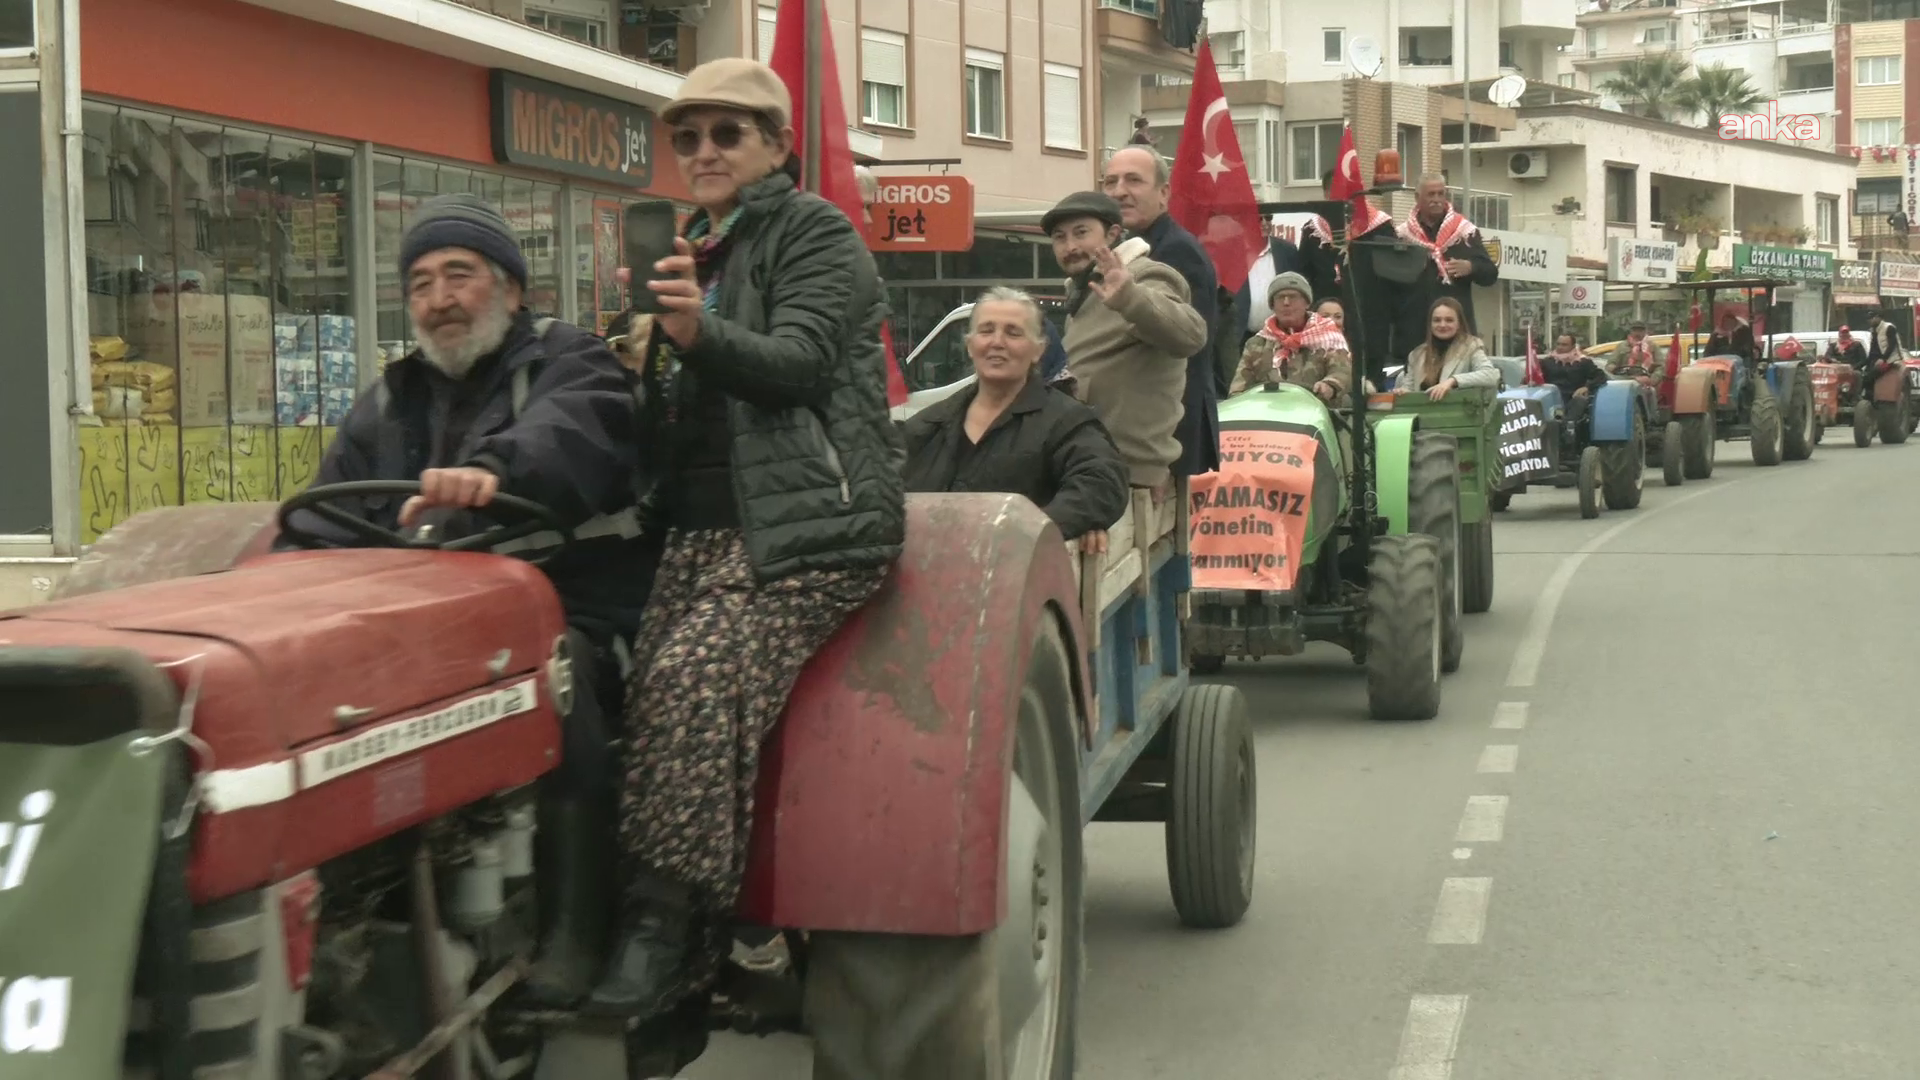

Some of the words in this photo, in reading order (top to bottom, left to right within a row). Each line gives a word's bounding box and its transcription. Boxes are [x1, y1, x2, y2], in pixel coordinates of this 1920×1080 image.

[621, 116, 647, 173] jet
[880, 208, 926, 242] jet
[1751, 245, 1800, 268] ÖZKANLAR
